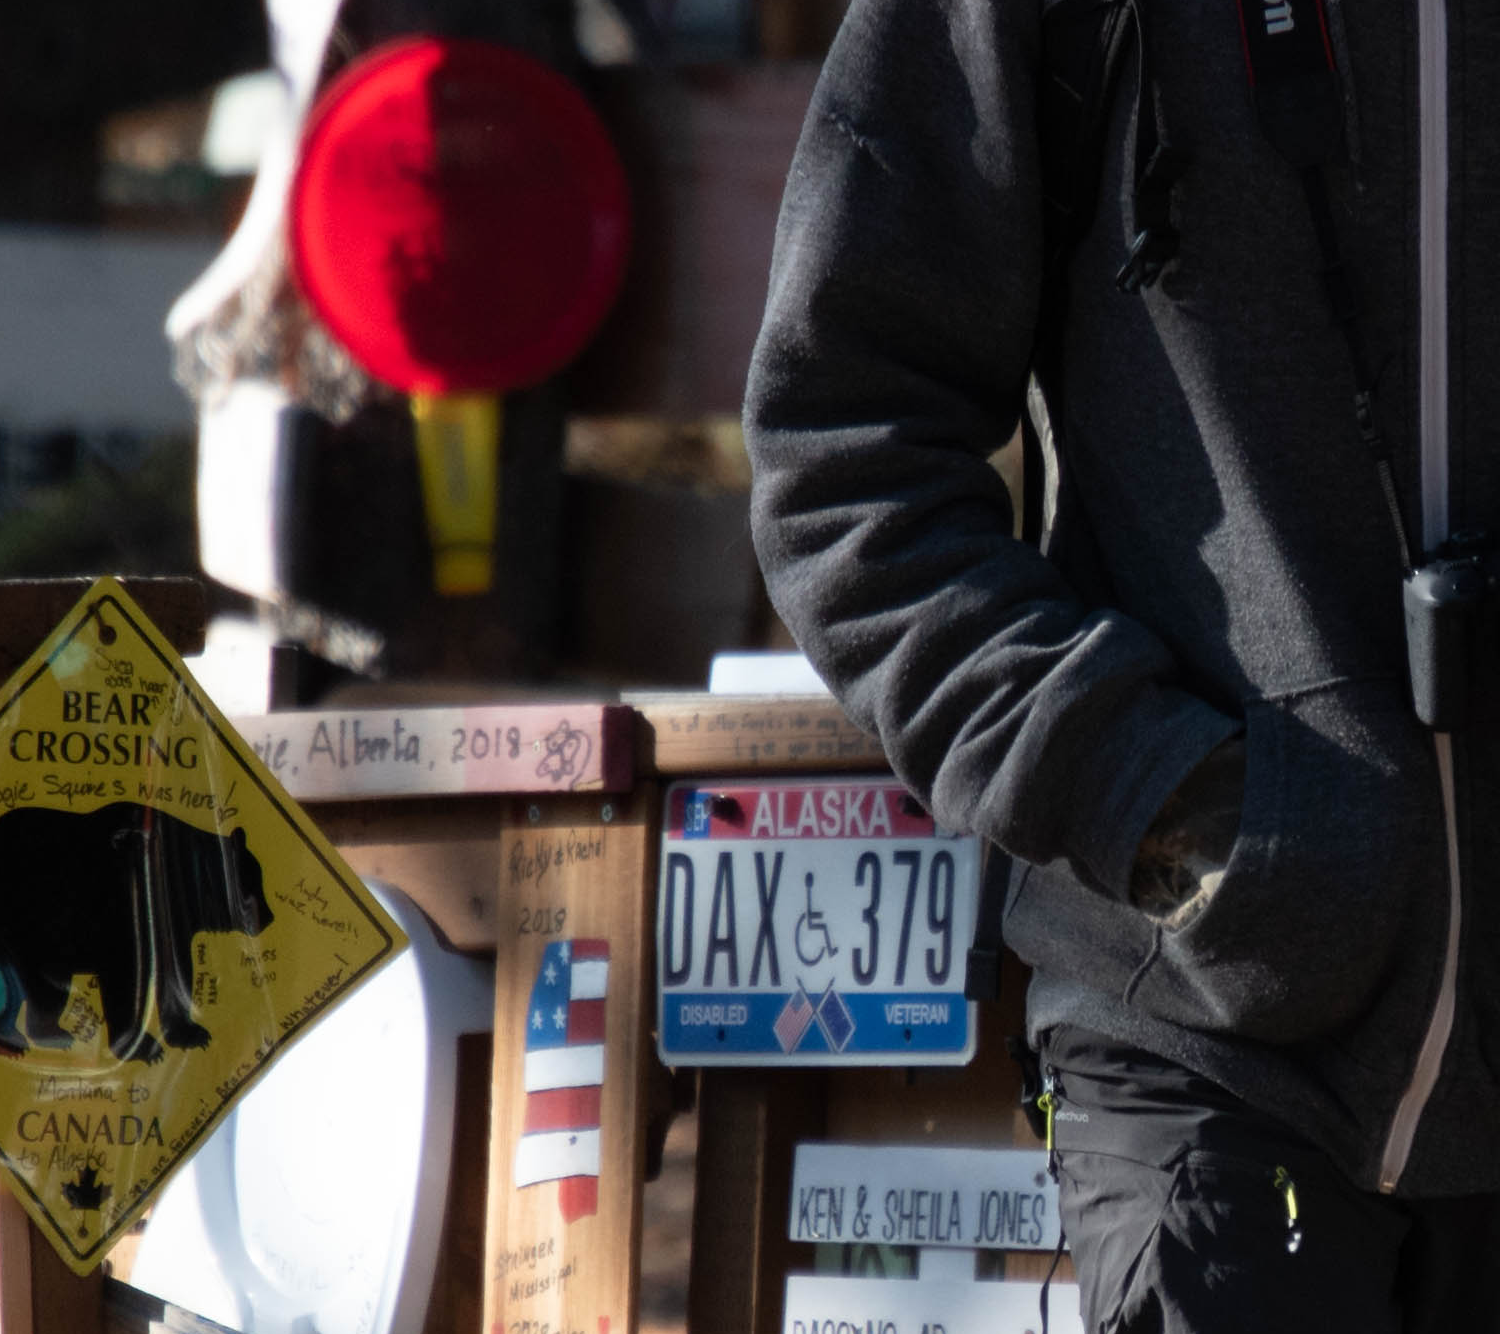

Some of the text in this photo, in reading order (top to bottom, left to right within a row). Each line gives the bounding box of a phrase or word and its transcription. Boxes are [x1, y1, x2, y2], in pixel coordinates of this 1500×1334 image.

[61, 689, 153, 726] BEAR
[8, 729, 199, 769] CROSSING
[307, 719, 522, 772] Alberta, 2018
[751, 790, 894, 838] ALASKA
[517, 907, 567, 937] 2018
[662, 849, 955, 988] DAX 379
[679, 1004, 949, 1027] DISABLED VETERAN
[15, 1109, 165, 1148] CANADA
[798, 1185, 1045, 1247] KEN SHEILA JONES
